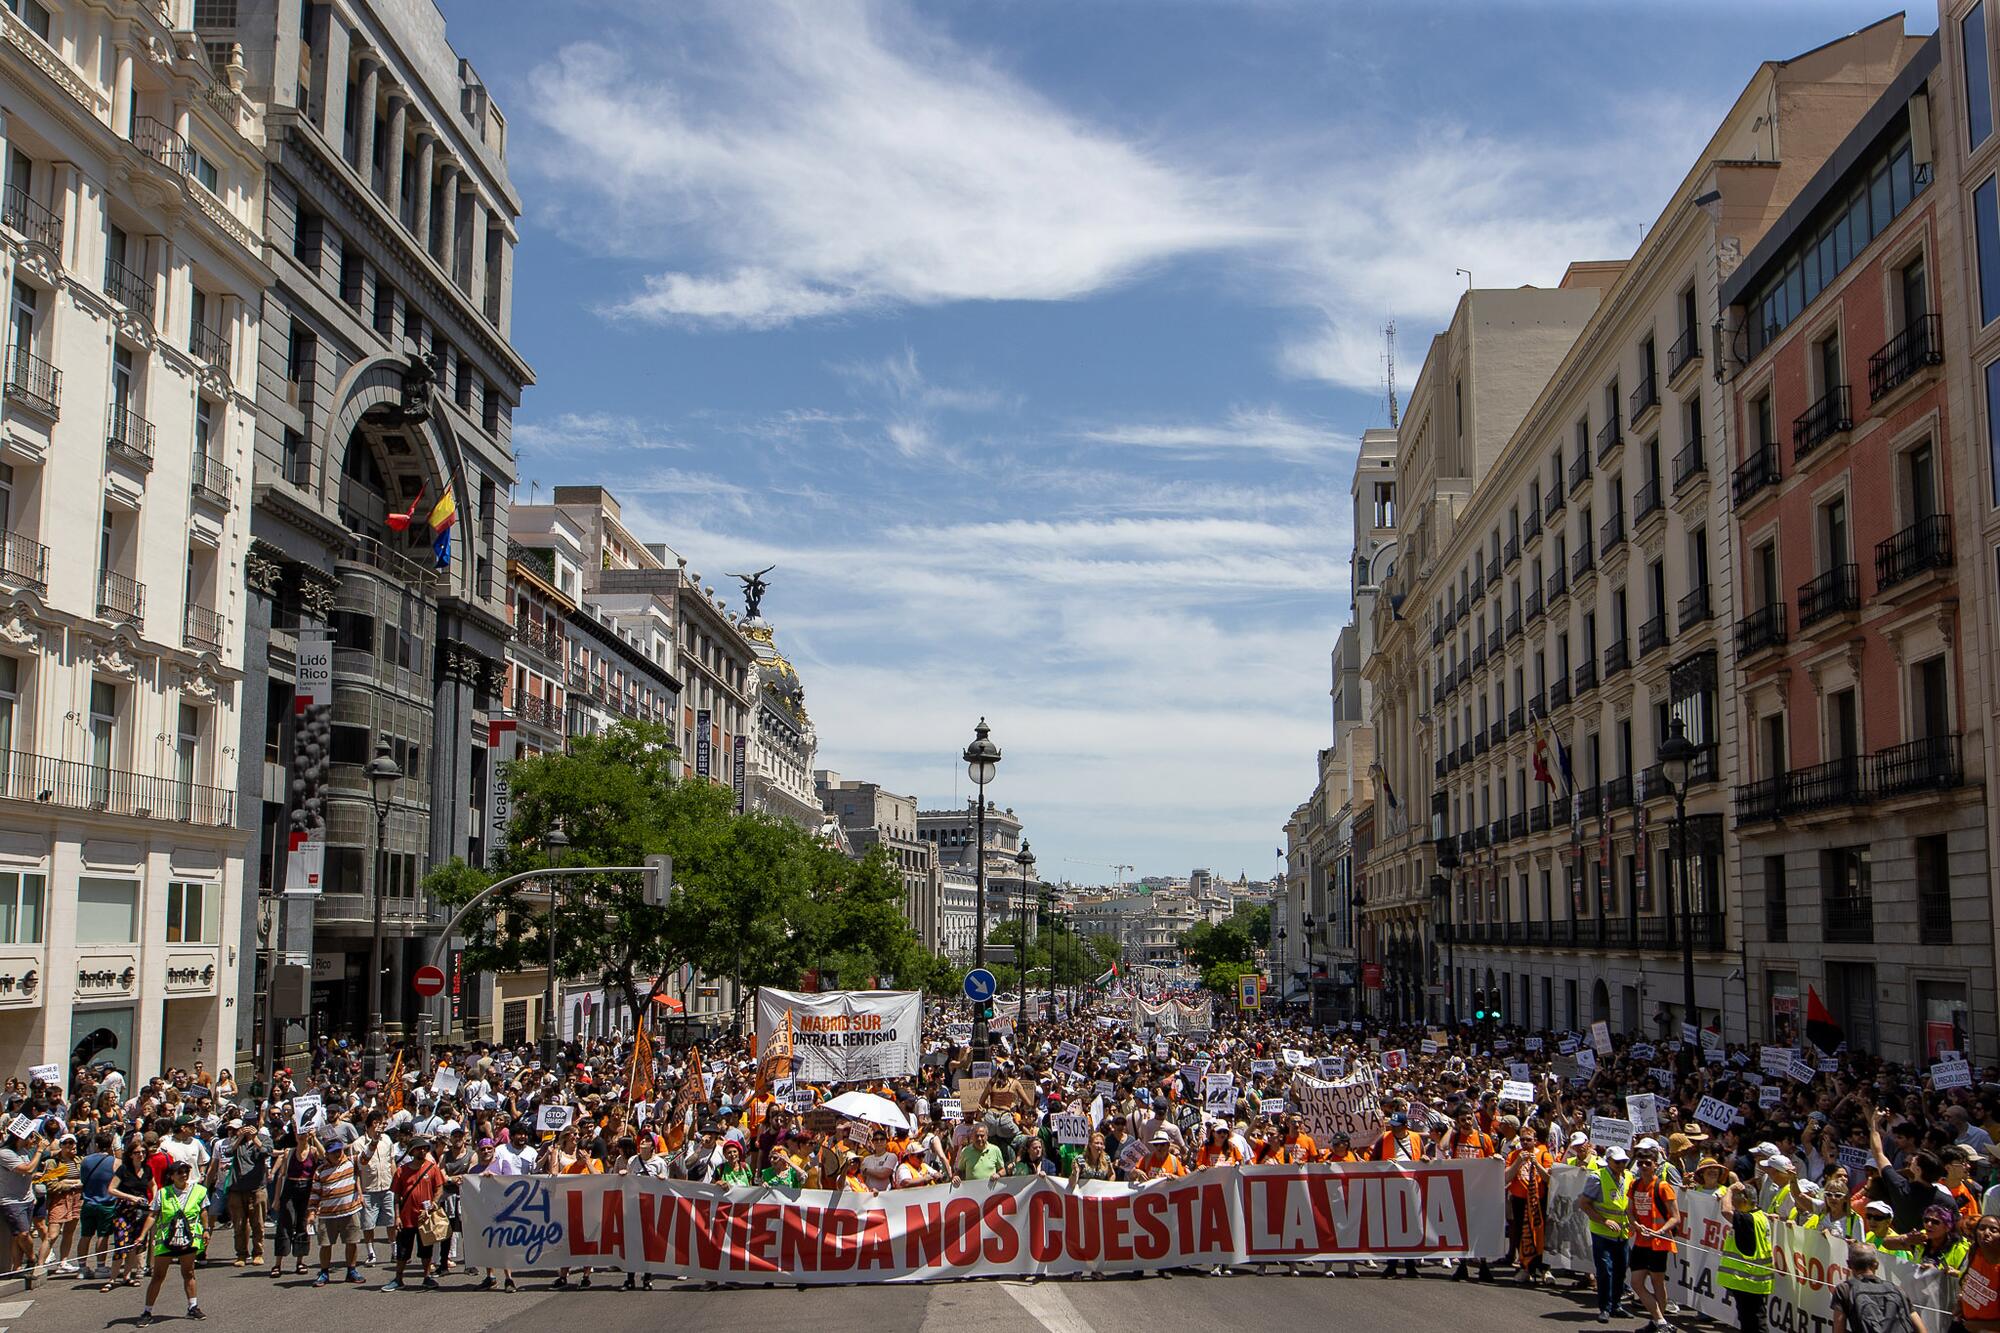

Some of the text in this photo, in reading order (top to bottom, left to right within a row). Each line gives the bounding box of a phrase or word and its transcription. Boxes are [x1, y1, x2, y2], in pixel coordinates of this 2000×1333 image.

[300, 655, 327, 665] Lidó
[300, 668, 328, 679] Rico
[492, 784, 508, 831] Alcalá
[225, 998, 234, 1007] 29
[800, 1013, 881, 1032] MADRID SUR
[792, 1028, 897, 1047] ONTRA EL RENTISMO
[1355, 1067, 1371, 1083] EN
[1346, 1083, 1374, 1099] POR
[939, 1100, 961, 1108] DERECH
[1840, 1147, 1868, 1158] ERECHO
[1842, 1154, 1867, 1165] TECHO
[495, 1179, 551, 1227] 24
[566, 1189, 626, 1260] LA
[639, 1192, 895, 1273] VIVIENDA
[904, 1192, 1020, 1269] NOS
[1028, 1184, 1235, 1263] CUESTA
[1250, 1179, 1319, 1250] LA
[1325, 1176, 1465, 1248] VIDA
[482, 1221, 563, 1265] mayo
